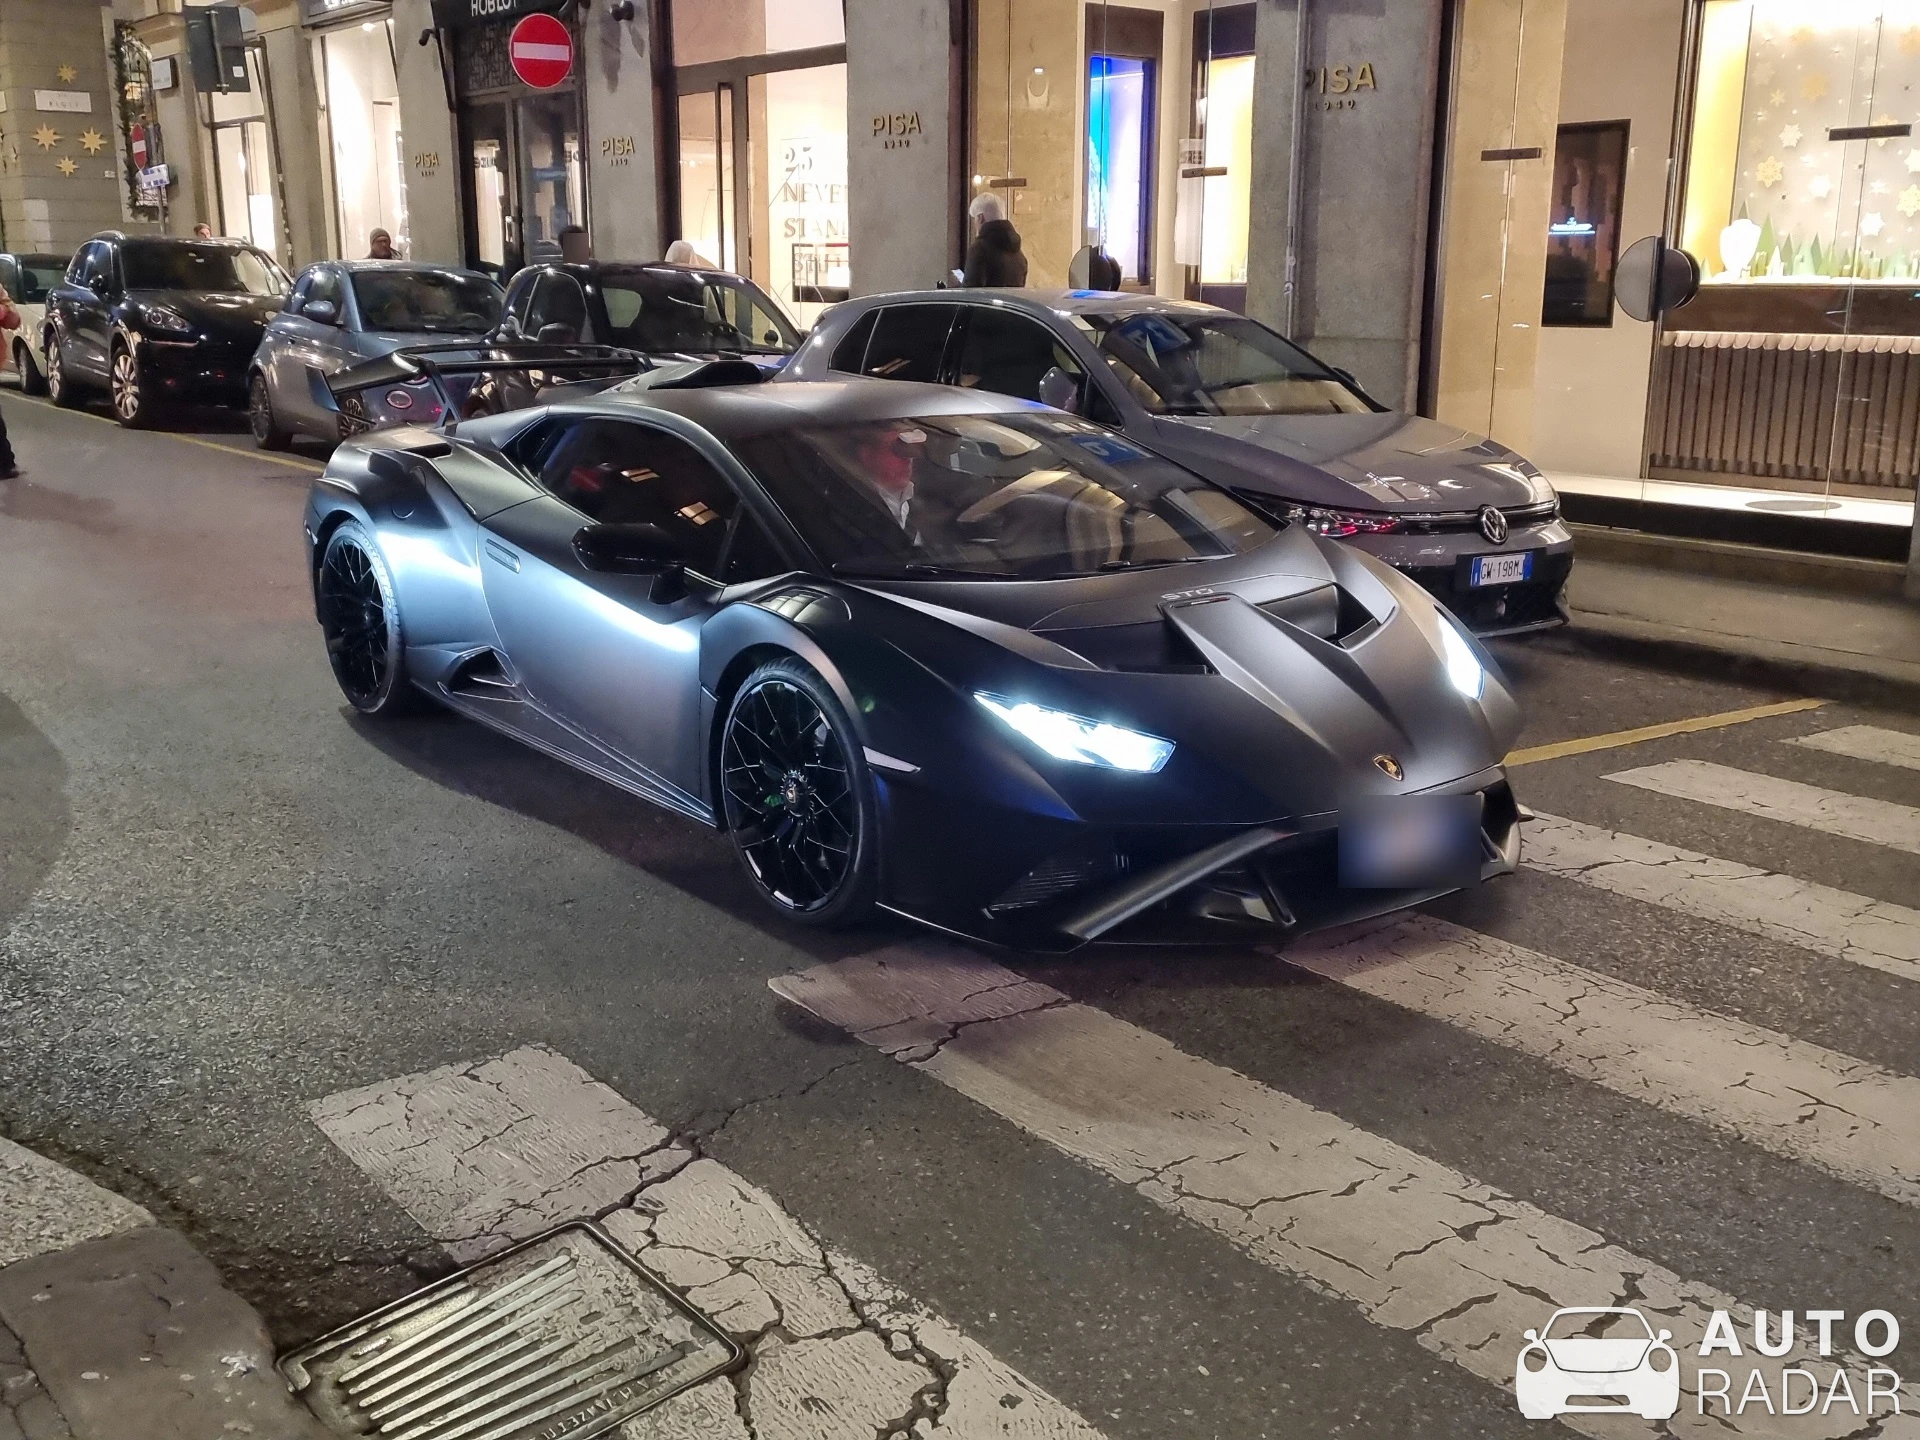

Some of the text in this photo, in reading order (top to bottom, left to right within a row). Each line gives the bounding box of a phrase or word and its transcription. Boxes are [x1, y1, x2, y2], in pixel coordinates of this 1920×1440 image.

[873, 111, 922, 137] PISA
[602, 135, 636, 157] PISA
[413, 151, 440, 168] PISA
[783, 183, 848, 203] NEVE
[1161, 588, 1214, 601] STO
